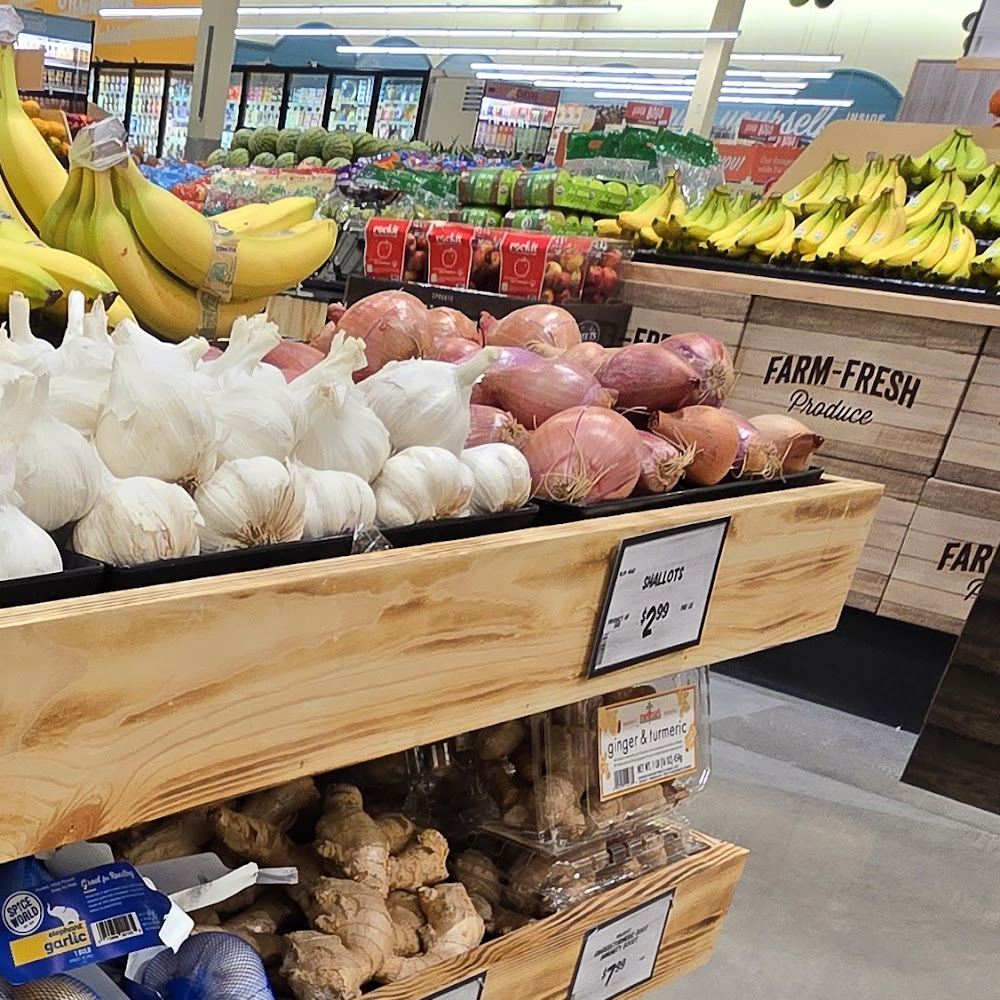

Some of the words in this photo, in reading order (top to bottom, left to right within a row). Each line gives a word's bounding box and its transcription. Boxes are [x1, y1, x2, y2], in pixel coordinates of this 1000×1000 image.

[764, 354, 921, 409] FARM-FRESH
[787, 388, 873, 426] Produce
[642, 566, 685, 590] SHALLOTS
[607, 735, 639, 759] ginger
[640, 729, 647, 745] &
[649, 722, 687, 743] turmeric
[7, 896, 32, 918] SPICE
[10, 906, 39, 929] WORLD
[48, 923, 83, 938] elephant
[44, 931, 88, 955] garlic
